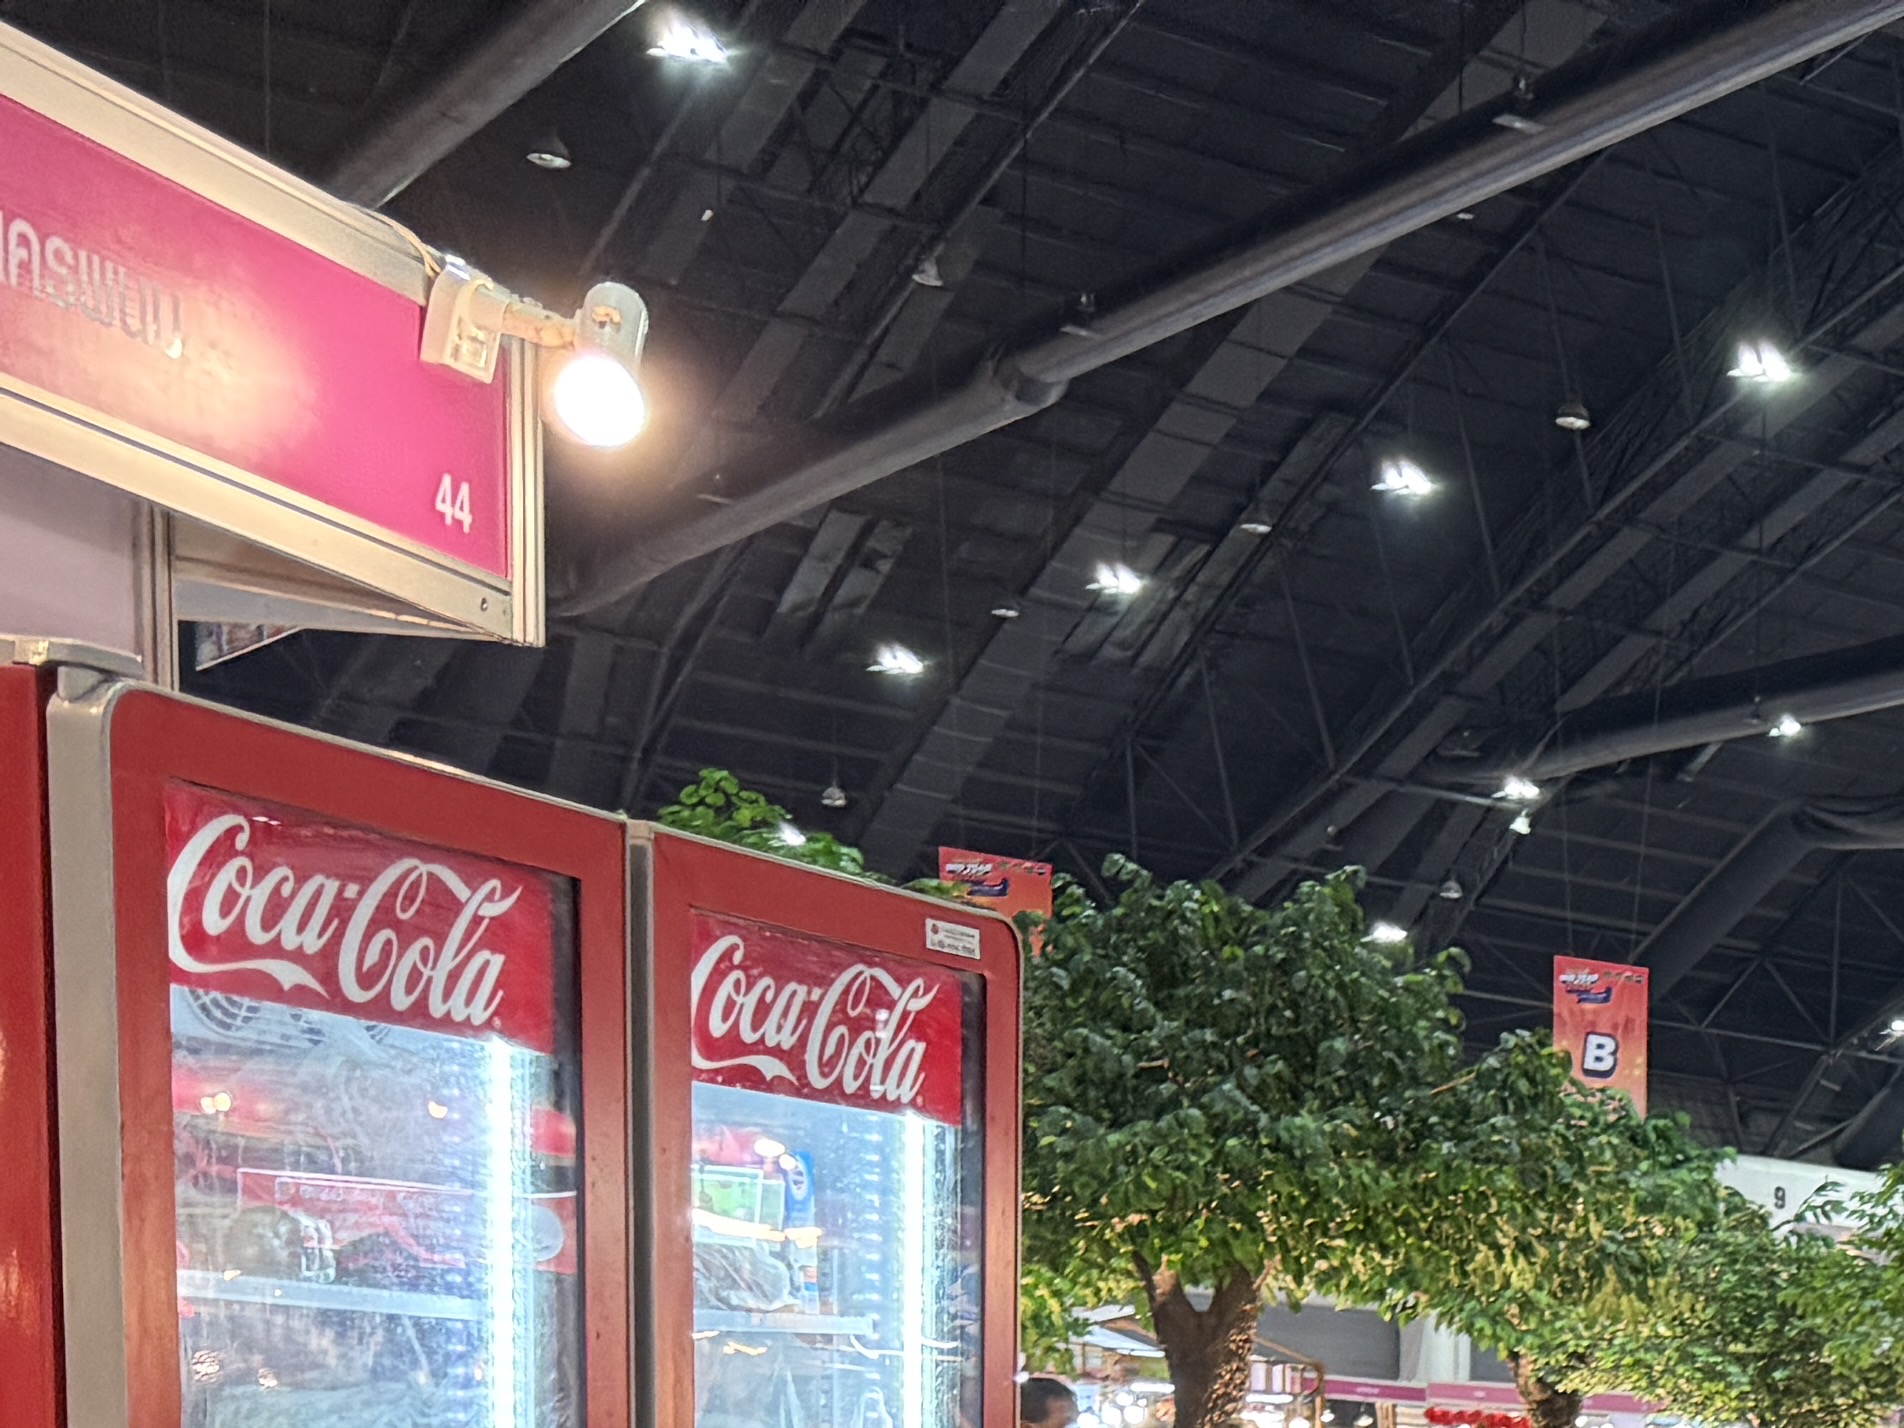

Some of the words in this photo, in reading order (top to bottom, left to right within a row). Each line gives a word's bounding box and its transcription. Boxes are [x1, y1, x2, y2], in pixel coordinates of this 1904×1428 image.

[0, 211, 183, 359] ครพนม
[434, 473, 472, 534] 44
[167, 811, 521, 1028] Coca-Cola
[689, 932, 938, 1104] Coca-Cola
[1582, 1033, 1618, 1077] B
[1774, 1186, 1785, 1209] 9
